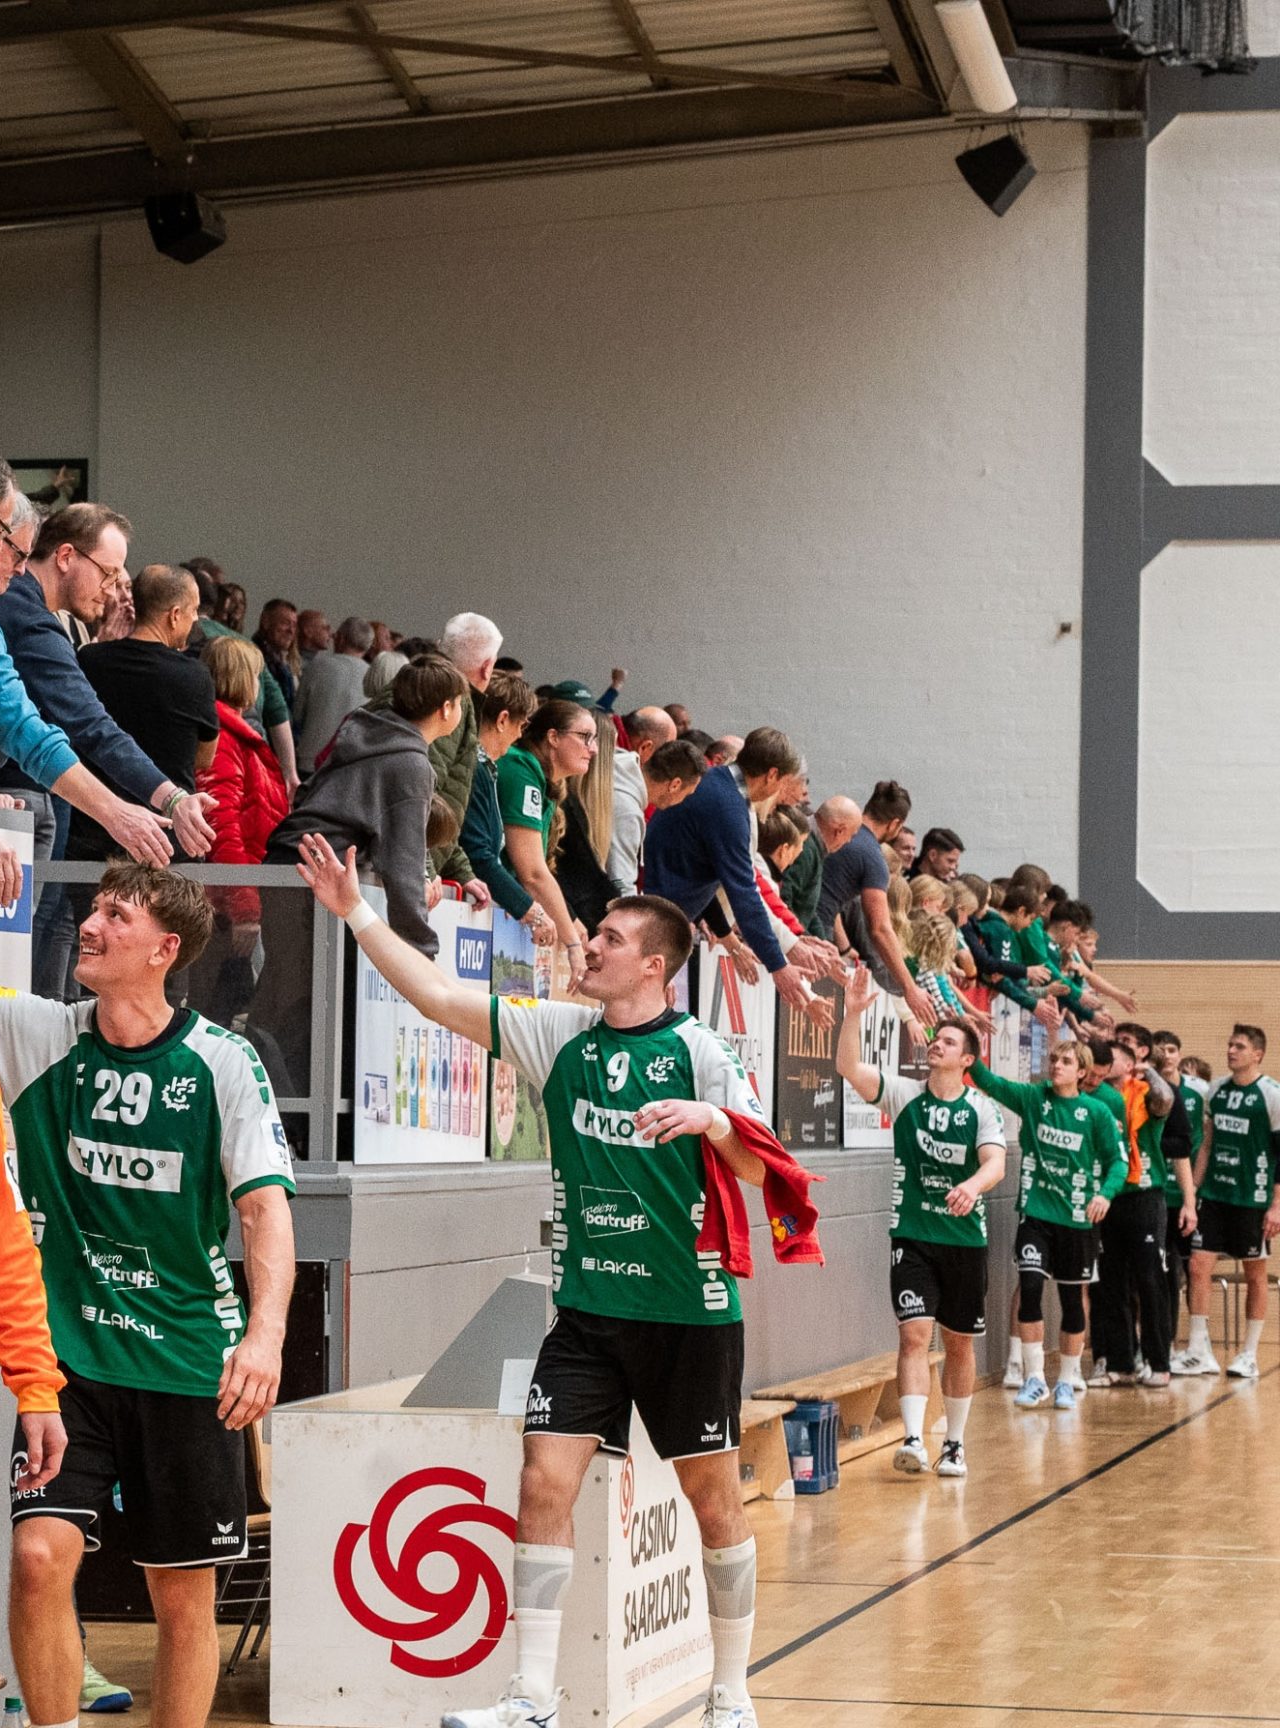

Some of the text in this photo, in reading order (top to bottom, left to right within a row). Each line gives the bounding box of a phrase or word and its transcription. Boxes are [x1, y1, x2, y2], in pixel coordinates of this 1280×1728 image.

[458, 938, 484, 971] HYLO
[606, 1051, 631, 1093] 9
[91, 1068, 153, 1126] 29
[928, 1105, 951, 1133] 19
[586, 1212, 645, 1231] bartruff
[597, 1259, 653, 1277] LAKAL
[701, 1432, 723, 1443] erima
[212, 1534, 240, 1546] erima
[630, 1497, 678, 1568] CASINO
[623, 1564, 691, 1650] SAARLOUIS
